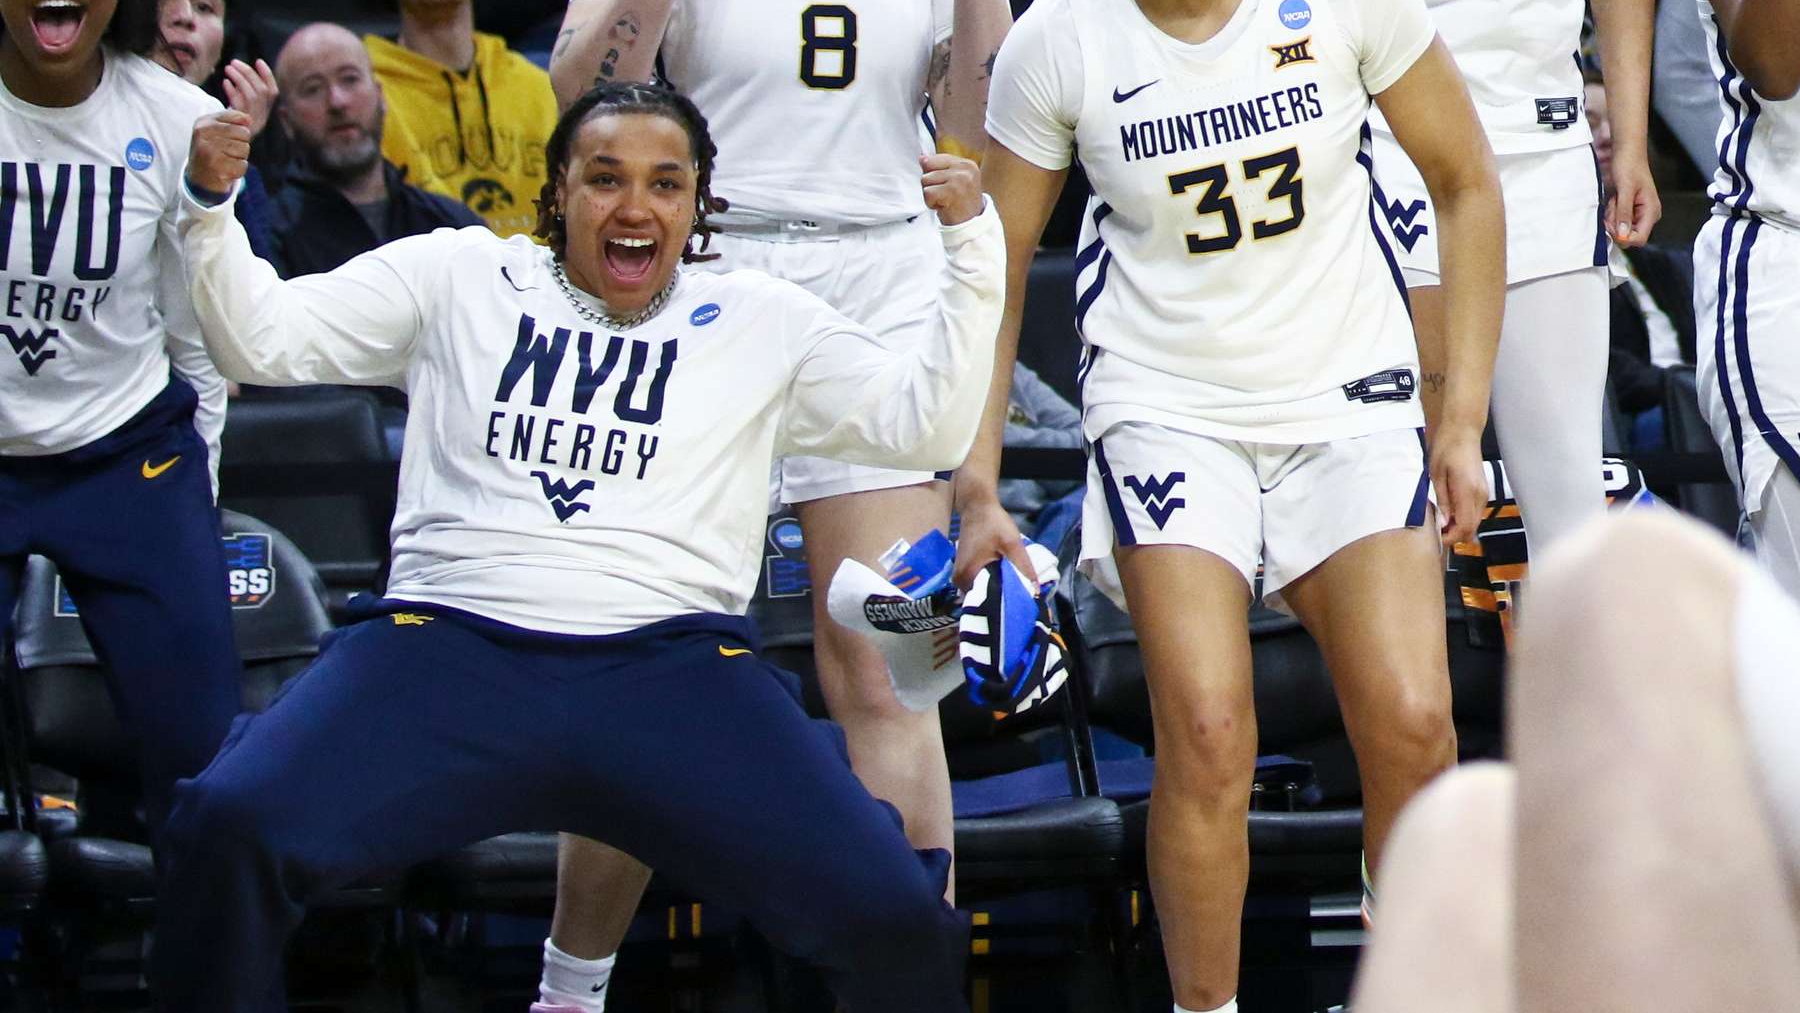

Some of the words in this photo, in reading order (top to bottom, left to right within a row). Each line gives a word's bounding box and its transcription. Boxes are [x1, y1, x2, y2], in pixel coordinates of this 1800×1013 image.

[799, 3, 857, 92] 8
[1120, 82, 1323, 163] MOUNTAINEERS
[1167, 145, 1306, 256] 33
[494, 312, 678, 426] WVU
[486, 410, 661, 480] ENERGY
[865, 596, 934, 623] MADNESS
